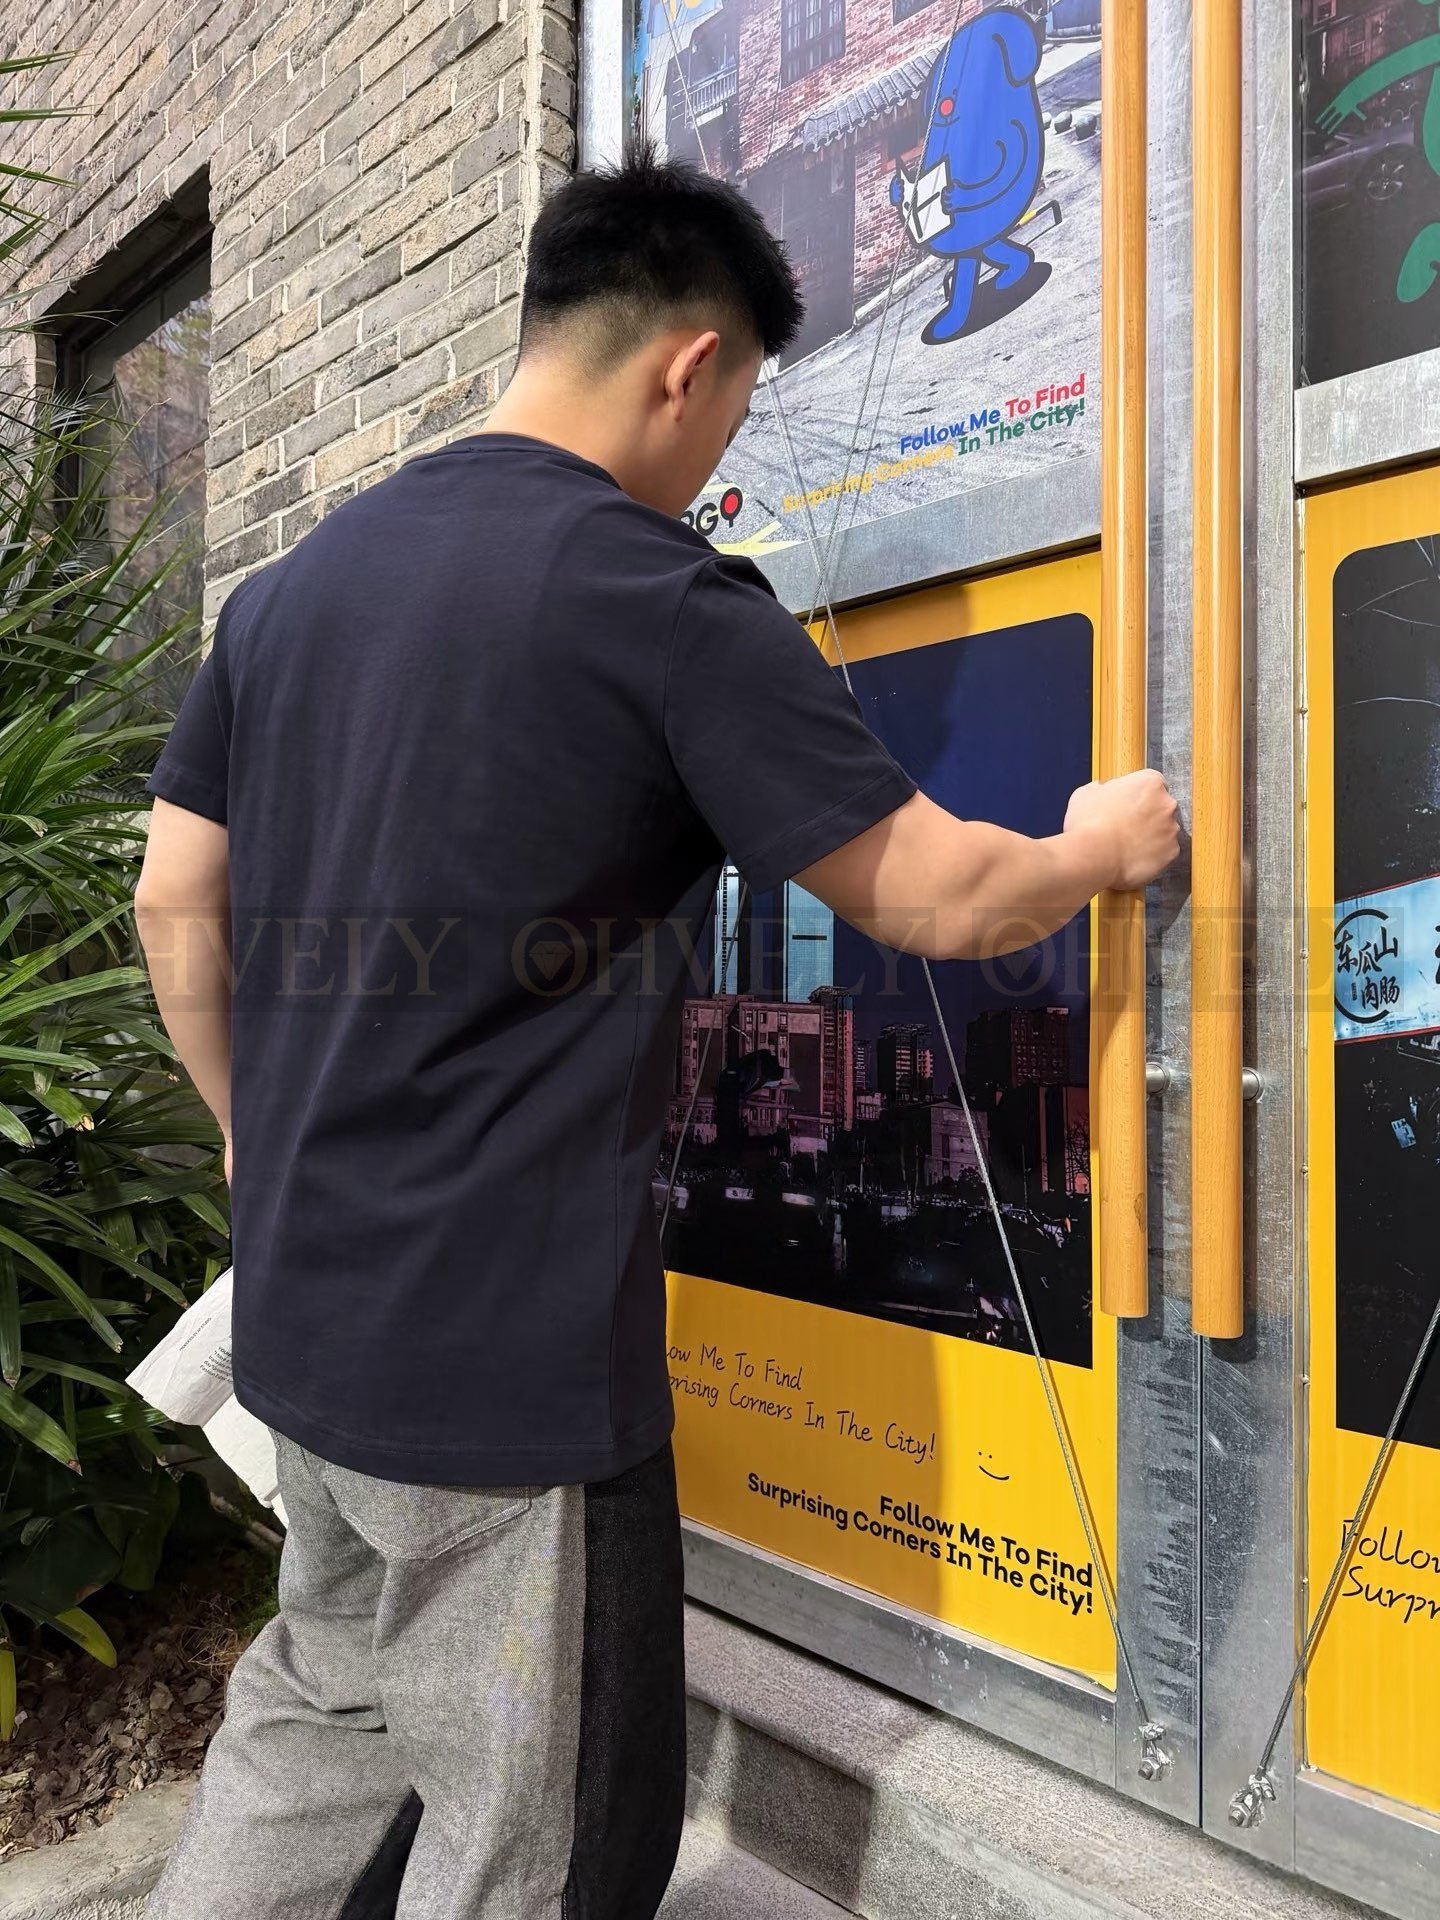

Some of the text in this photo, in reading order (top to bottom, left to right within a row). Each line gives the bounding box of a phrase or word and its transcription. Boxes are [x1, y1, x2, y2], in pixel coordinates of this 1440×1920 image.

[900, 373, 1085, 455] Follow Me To Find
[782, 398, 1085, 514] Surprising Corners In The City!
[1334, 926, 1398, 976] 东瓜山
[1361, 976, 1400, 1010] 肉肠
[700, 1343, 726, 1371] Me
[735, 1352, 754, 1377] To
[765, 1359, 802, 1391] Find
[729, 1382, 793, 1420] Corners
[804, 1401, 824, 1429] In
[836, 1410, 873, 1441] The
[885, 1422, 936, 1464] City!
[748, 1472, 1092, 1616] Surprising Corners In The City!
[880, 1495, 1092, 1587] Follow Me To Find
